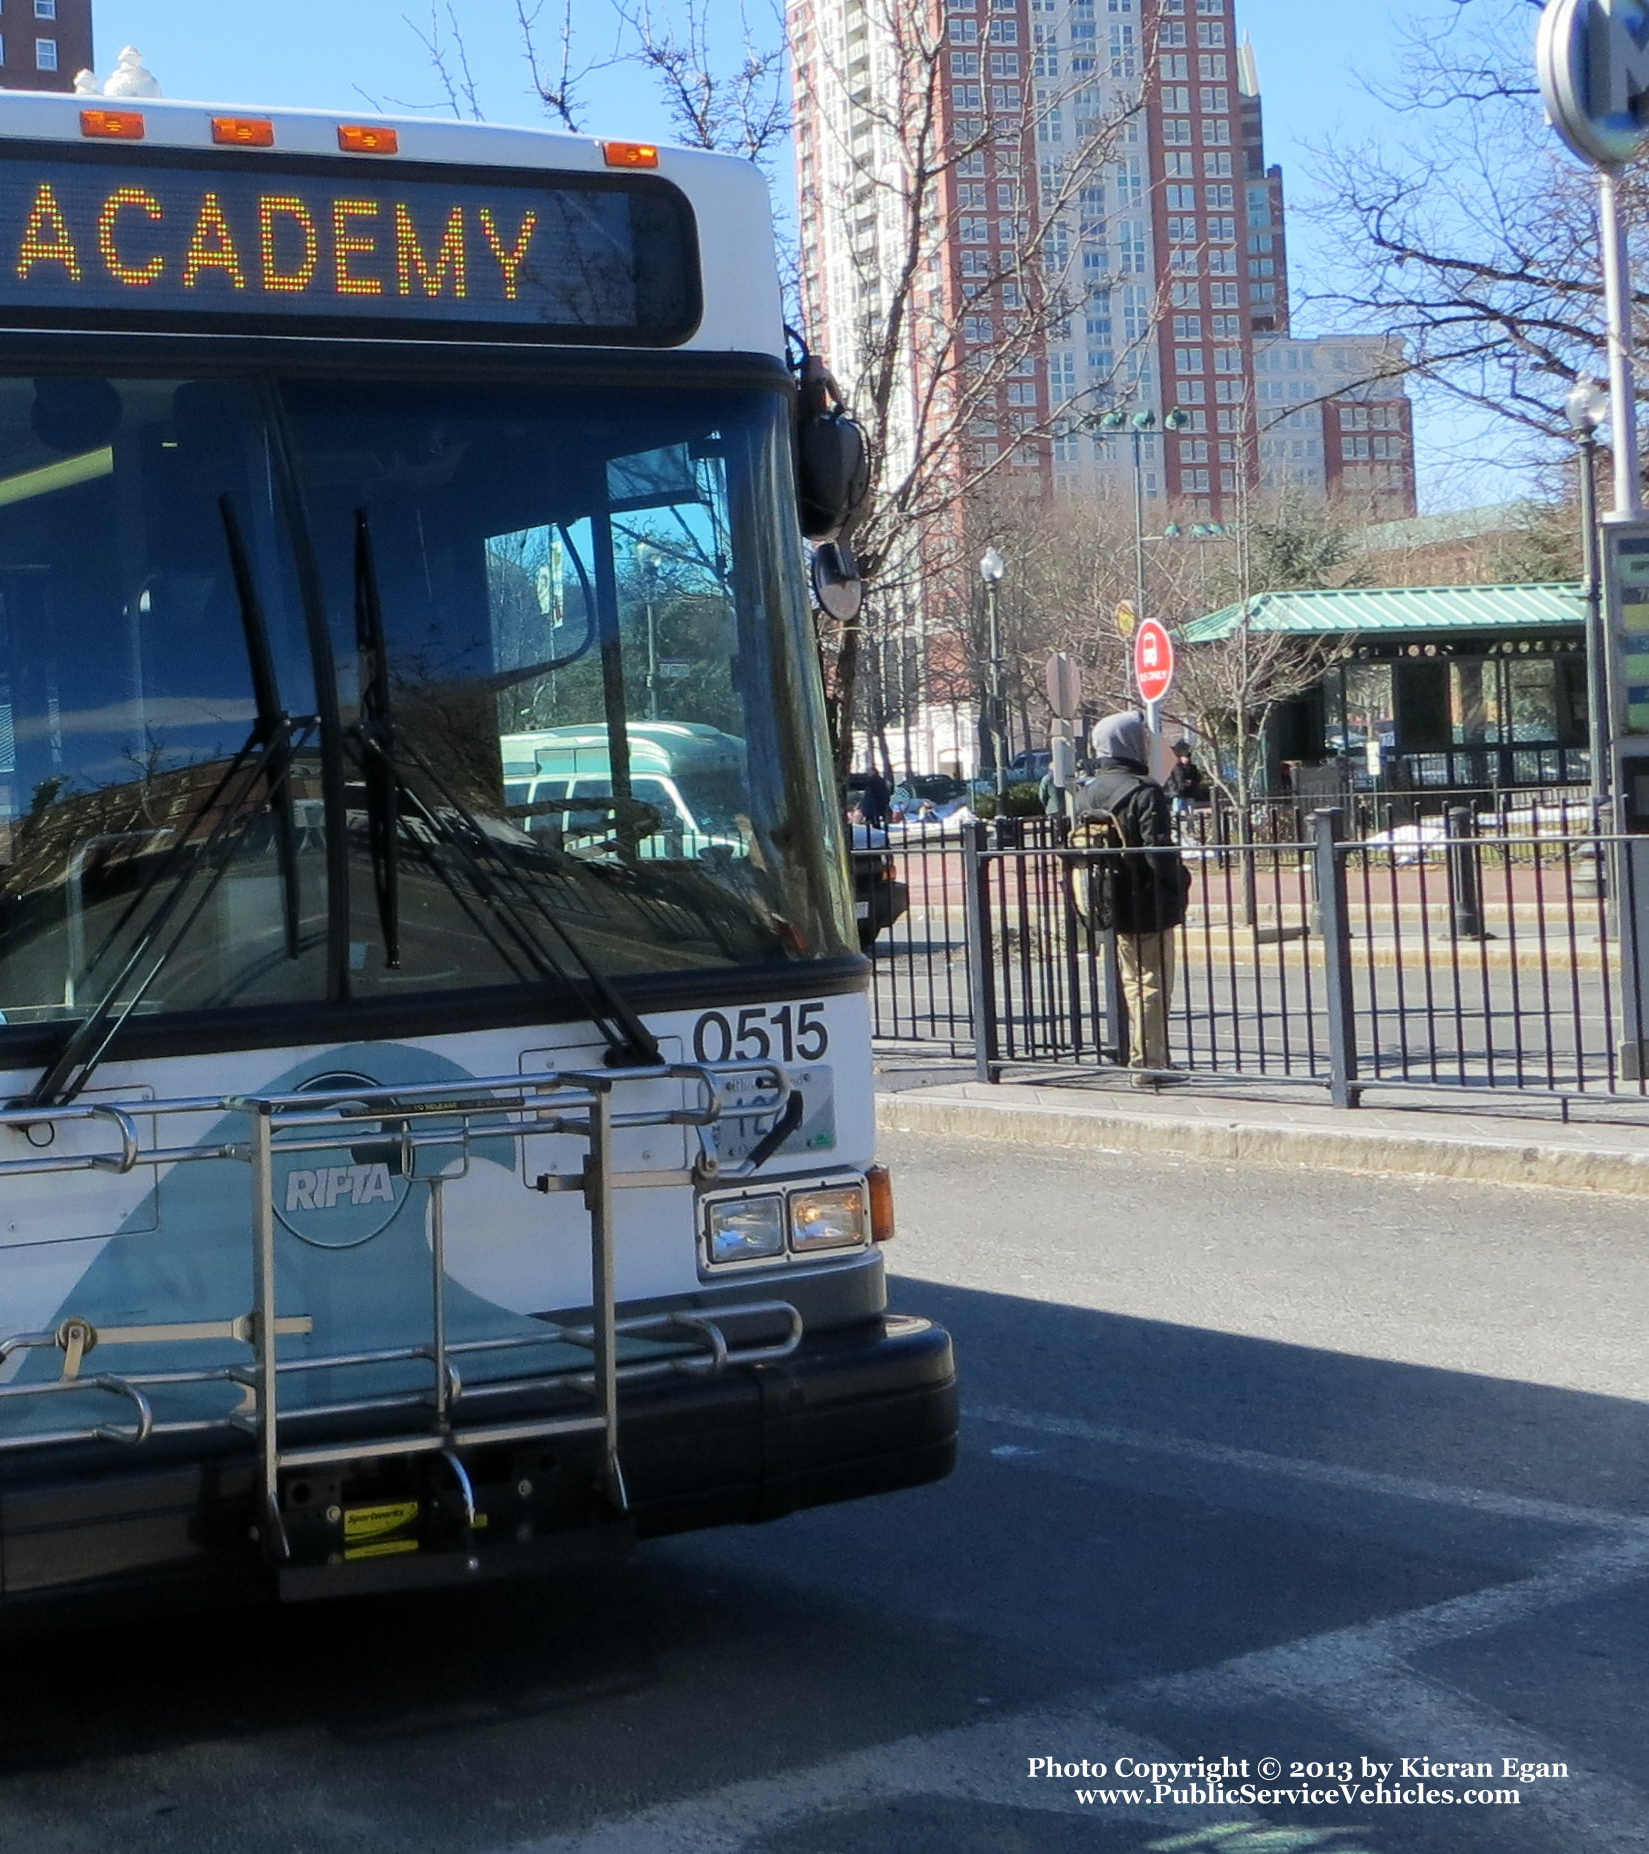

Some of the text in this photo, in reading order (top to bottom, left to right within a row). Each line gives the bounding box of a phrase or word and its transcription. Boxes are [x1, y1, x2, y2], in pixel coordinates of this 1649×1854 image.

[15, 183, 538, 300] ACADEMY
[693, 1002, 828, 1062] 0515
[286, 1163, 396, 1212] RIPTA
